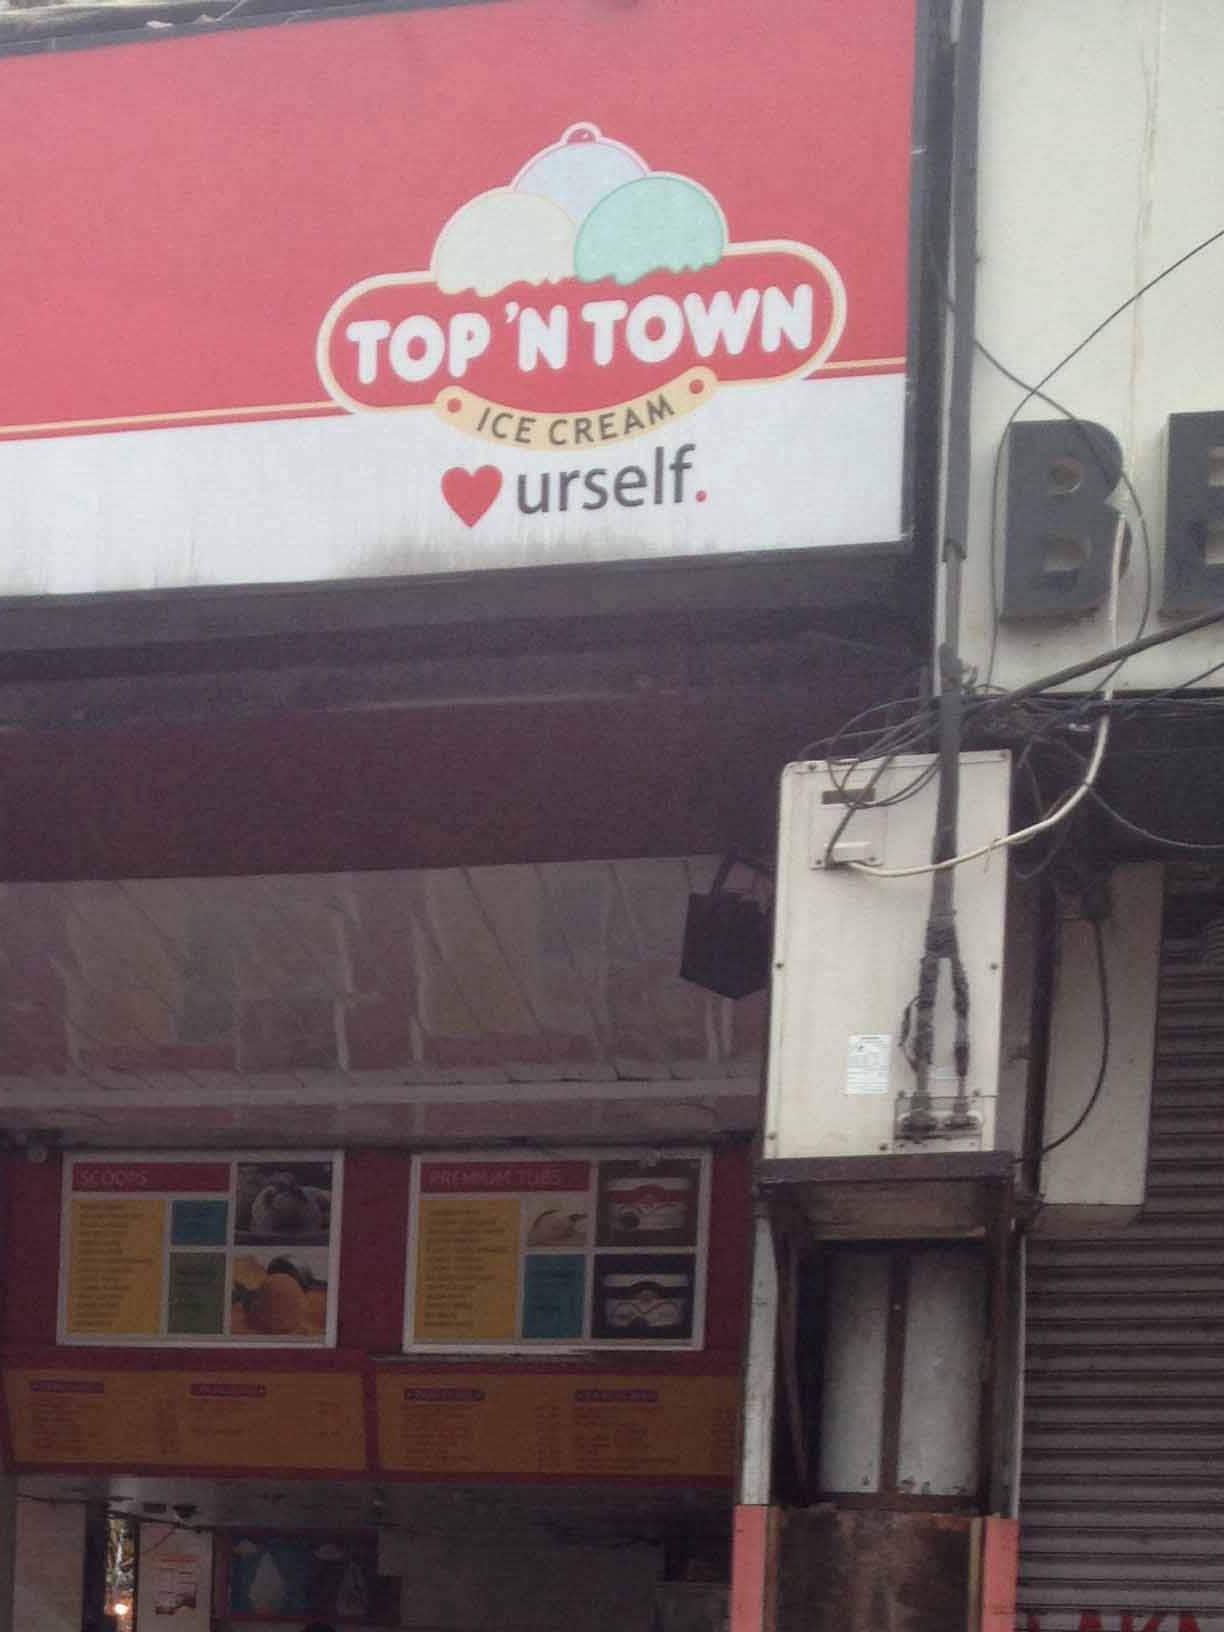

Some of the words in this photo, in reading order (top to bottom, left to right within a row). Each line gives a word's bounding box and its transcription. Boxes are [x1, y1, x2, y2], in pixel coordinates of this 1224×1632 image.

[345, 312, 492, 385] TOP
[580, 283, 814, 367] TOWN
[475, 405, 538, 445] ICE
[548, 393, 677, 447] CREAM
[516, 442, 708, 516] urself.
